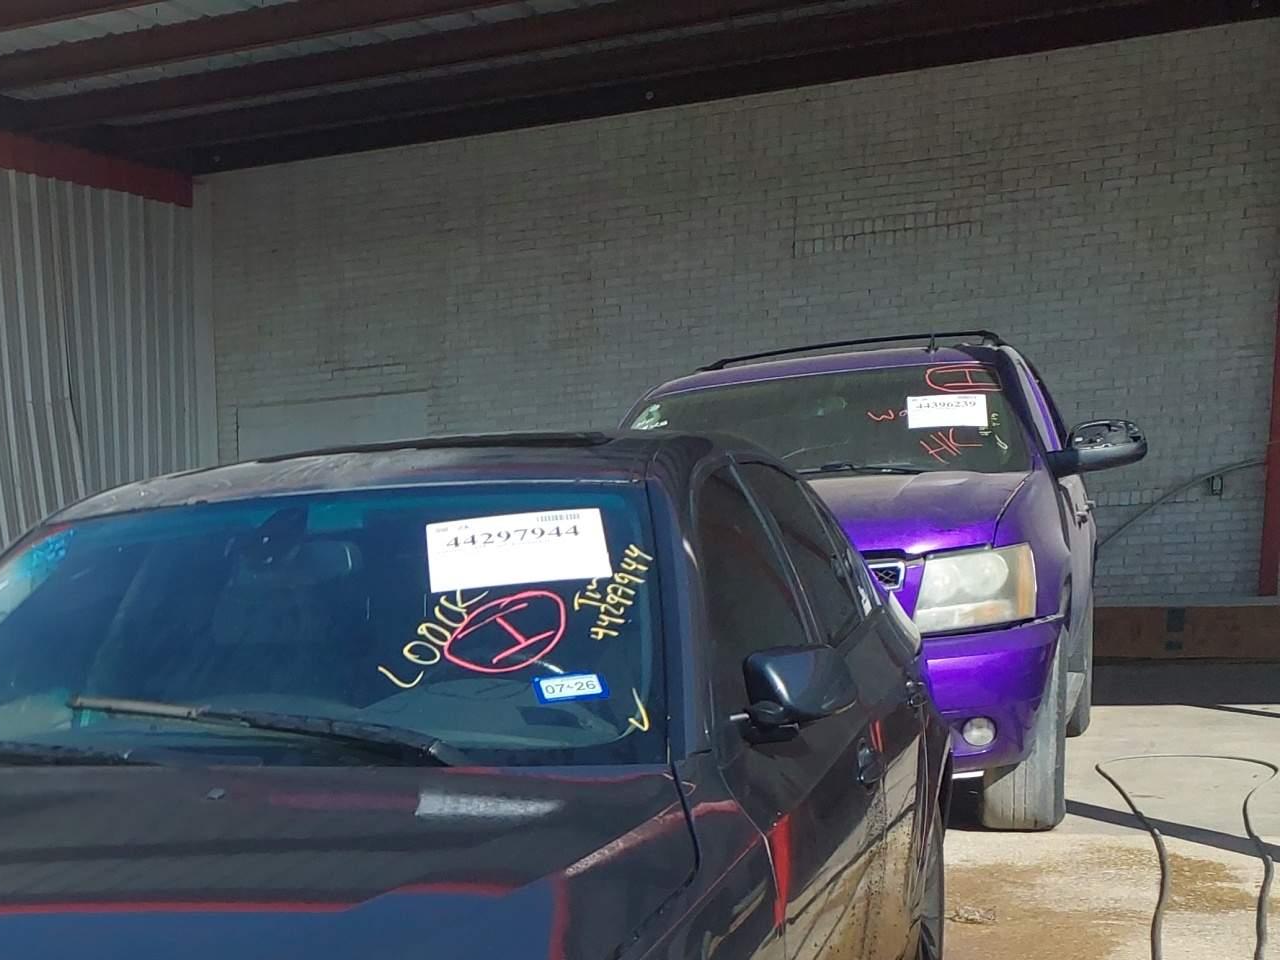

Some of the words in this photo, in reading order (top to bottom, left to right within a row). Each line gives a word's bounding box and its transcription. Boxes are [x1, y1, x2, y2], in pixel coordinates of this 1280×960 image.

[446, 524, 581, 549] 44297944
[589, 543, 654, 640] 44297944
[544, 680, 598, 695] 07-26
